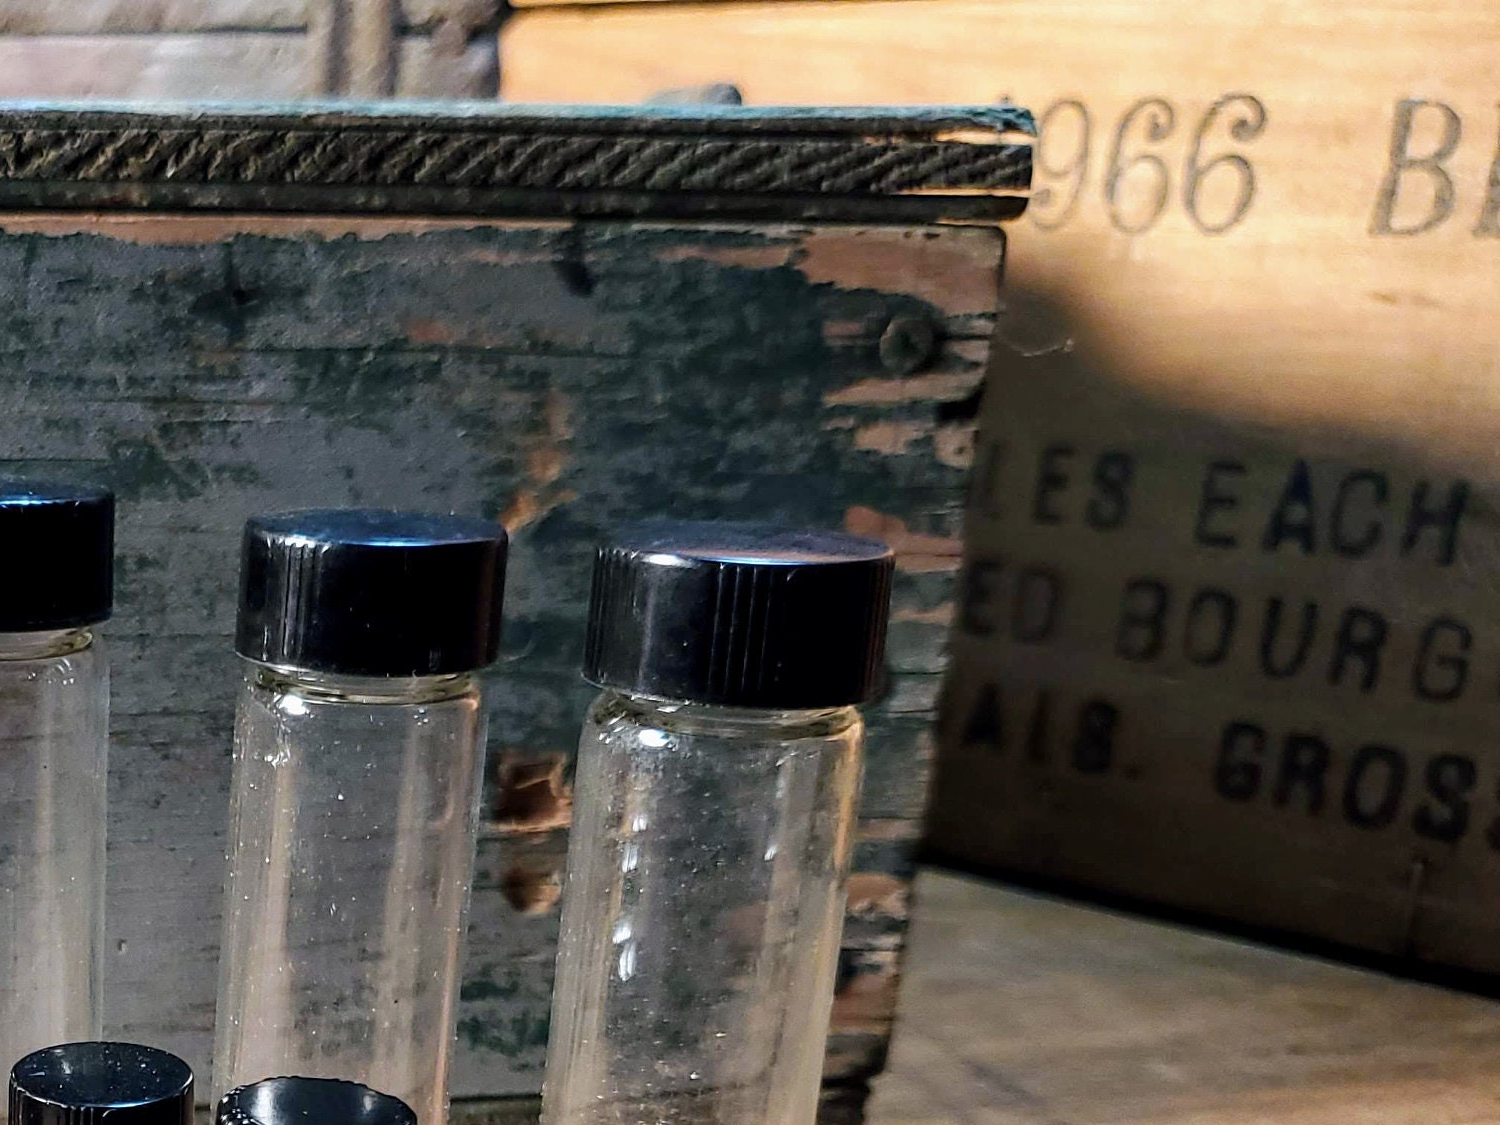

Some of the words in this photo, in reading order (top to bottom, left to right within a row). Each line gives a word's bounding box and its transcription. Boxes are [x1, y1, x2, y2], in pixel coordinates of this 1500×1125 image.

[1026, 94, 1267, 234] 966
[1194, 457, 1471, 566] EACH
[1114, 575, 1485, 702] BOURG
[1213, 718, 1500, 850] GROS
